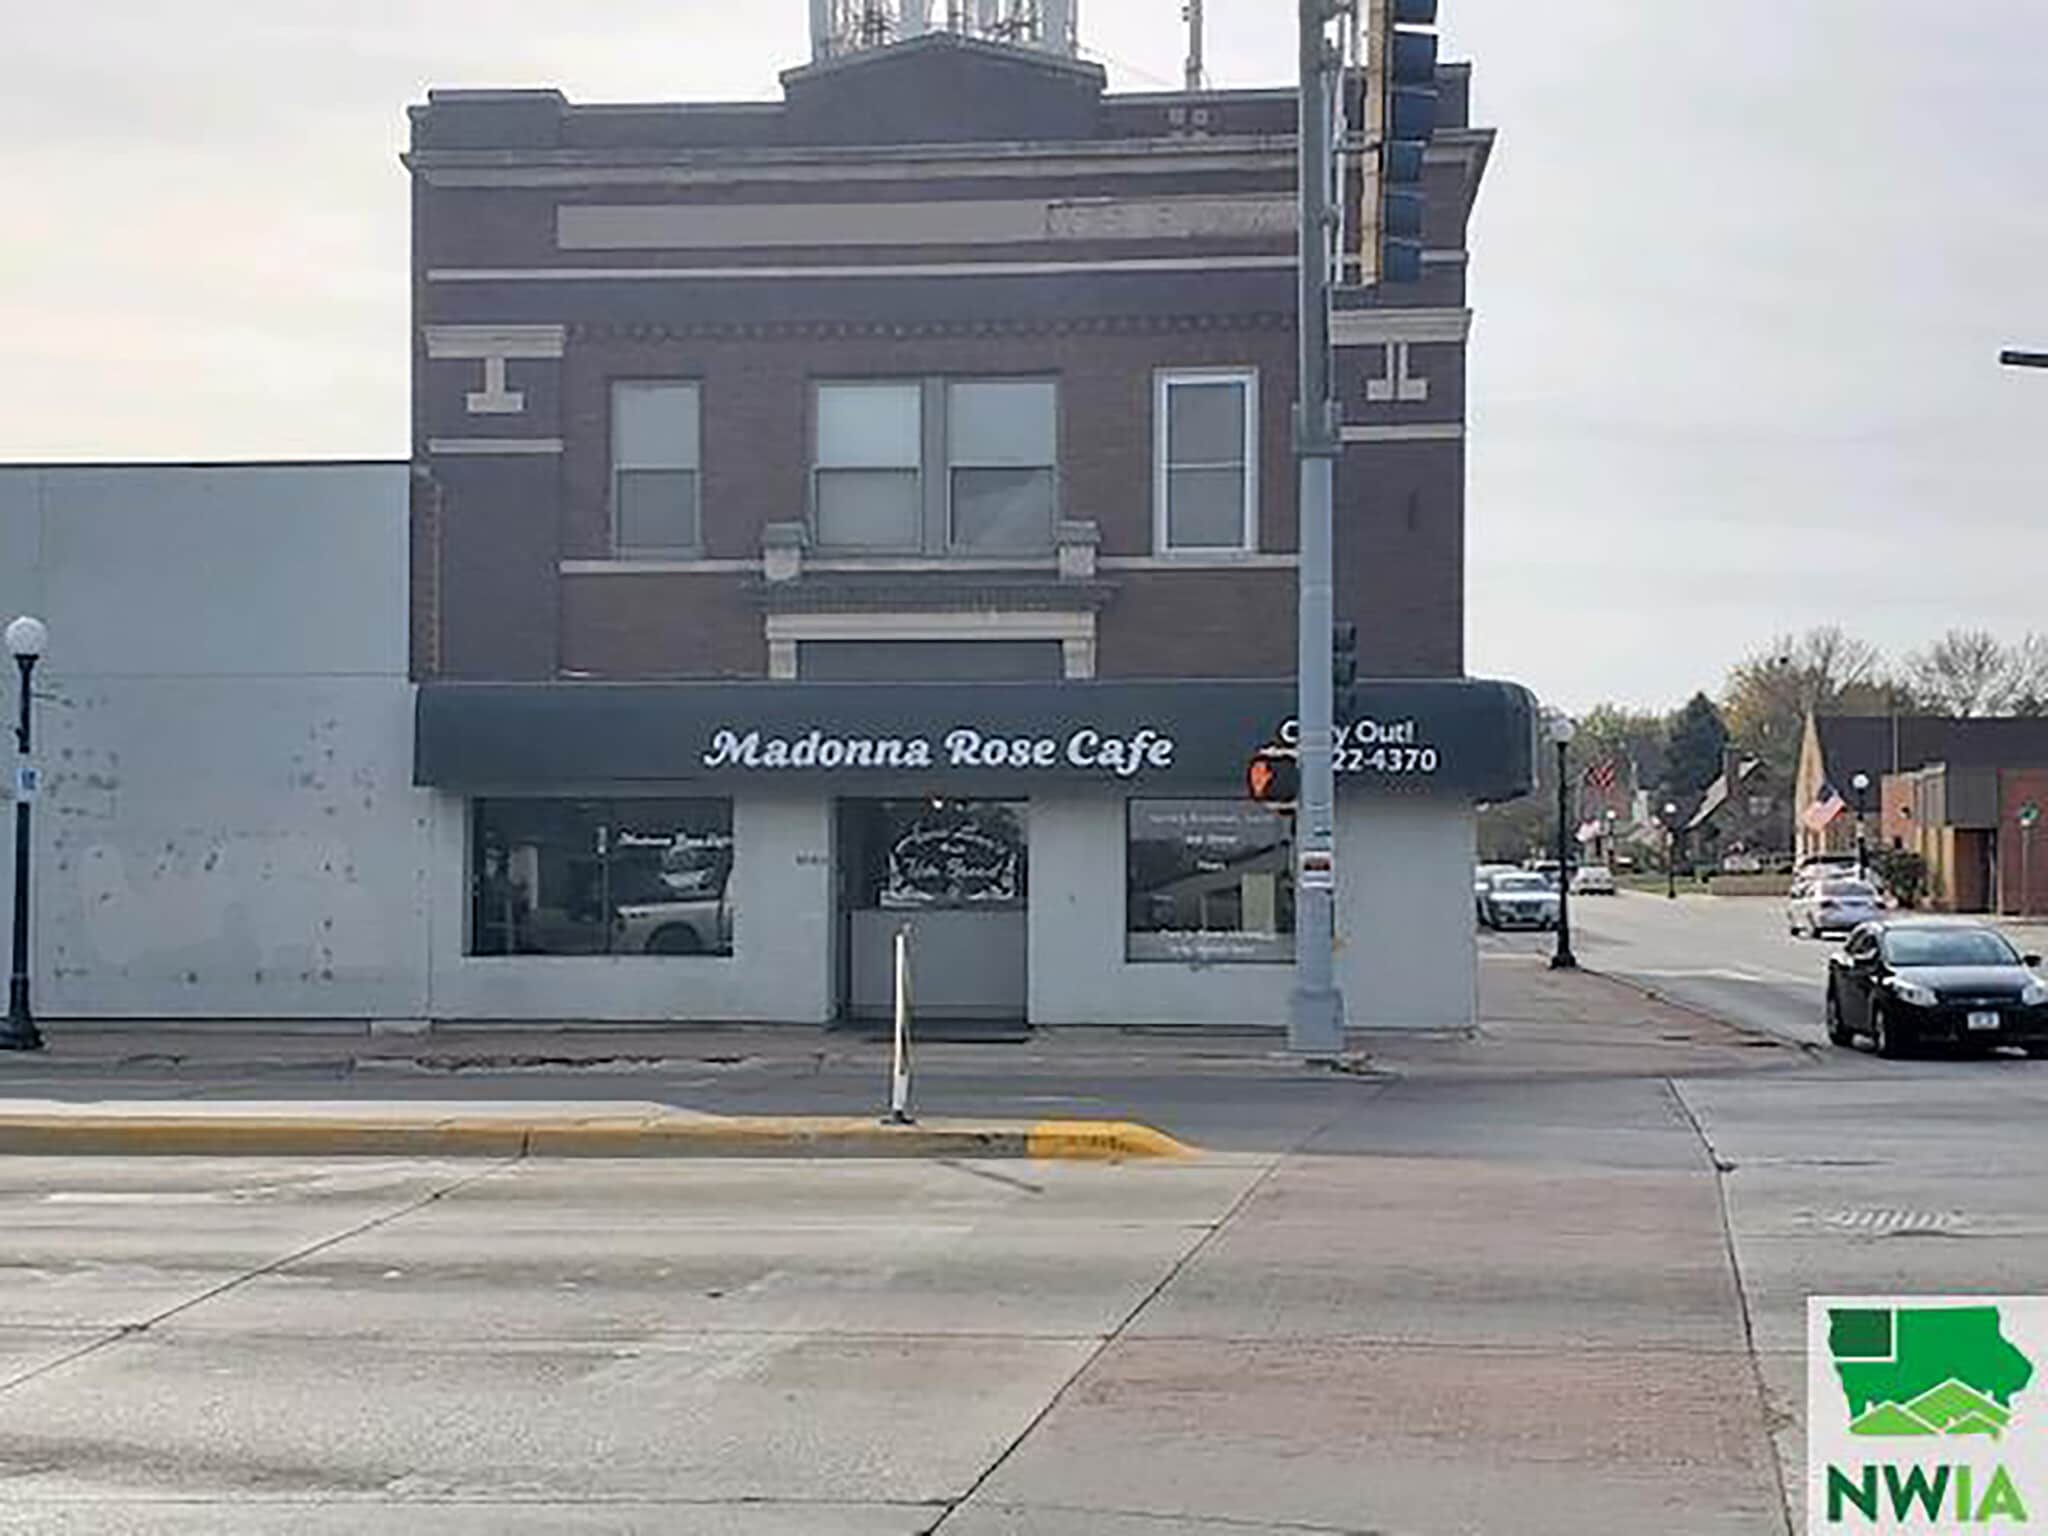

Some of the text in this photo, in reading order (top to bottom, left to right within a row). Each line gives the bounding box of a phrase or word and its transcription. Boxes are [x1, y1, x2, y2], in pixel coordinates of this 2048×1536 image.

[1354, 719, 1415, 744] Out!
[703, 729, 1174, 775] Madonna Rose Cafe
[1331, 747, 1438, 771] 22-4370
